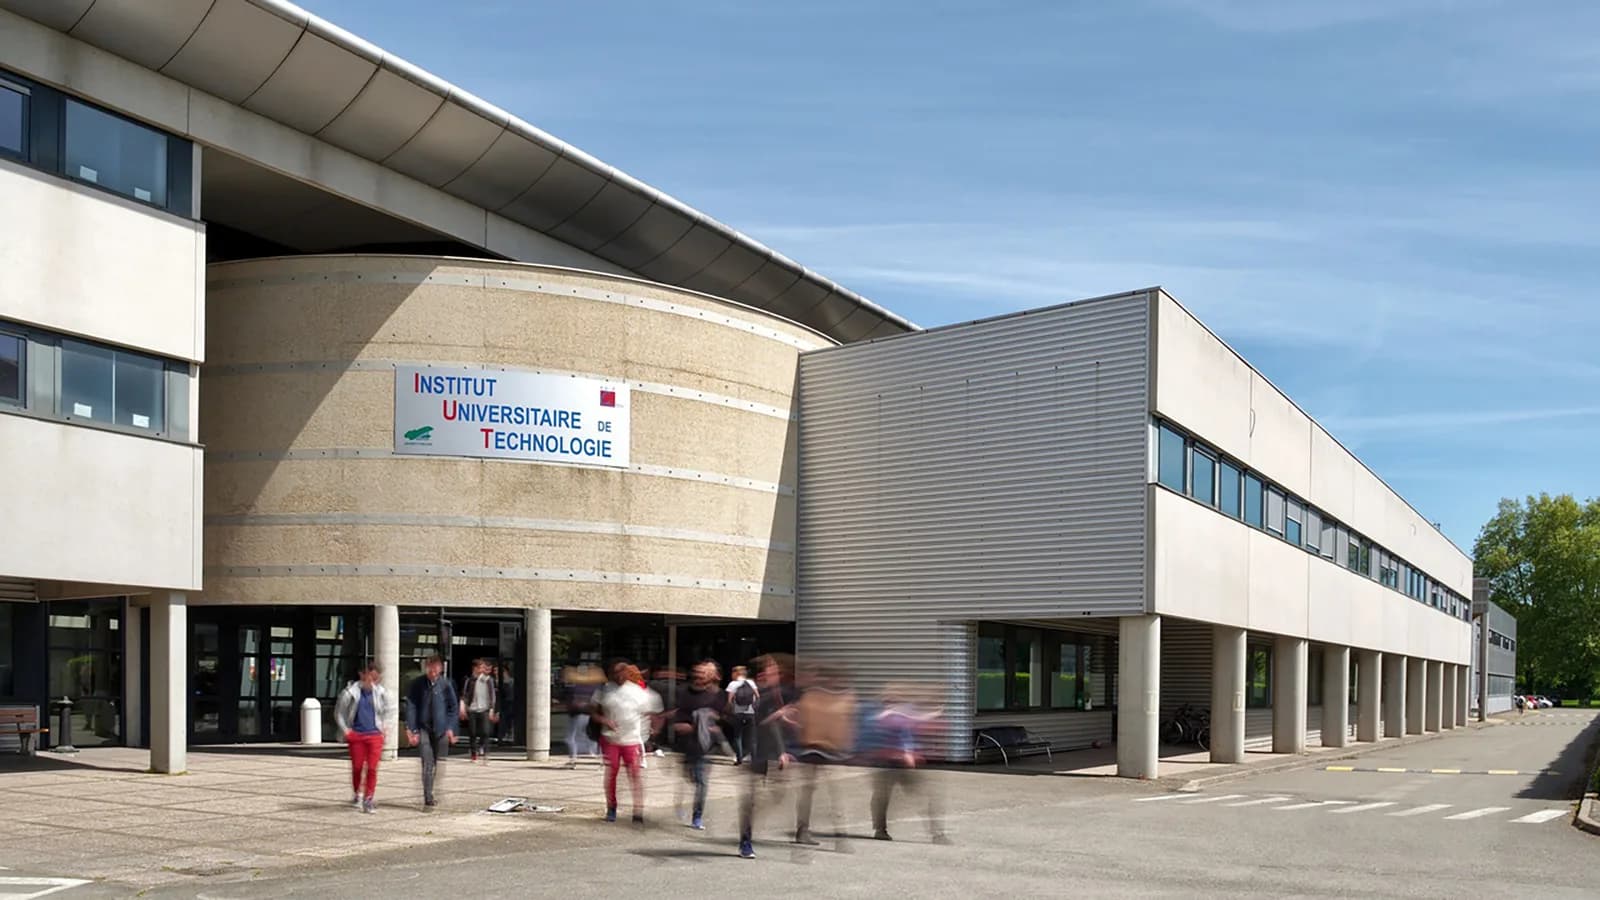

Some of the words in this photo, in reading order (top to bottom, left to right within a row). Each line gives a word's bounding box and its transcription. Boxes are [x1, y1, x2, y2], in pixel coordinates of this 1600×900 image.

[414, 373, 497, 396] INSTITUT
[443, 400, 581, 429] UNIVERSITAIRE
[597, 421, 612, 432] DE
[480, 428, 612, 457] TECHNOLOGIE
